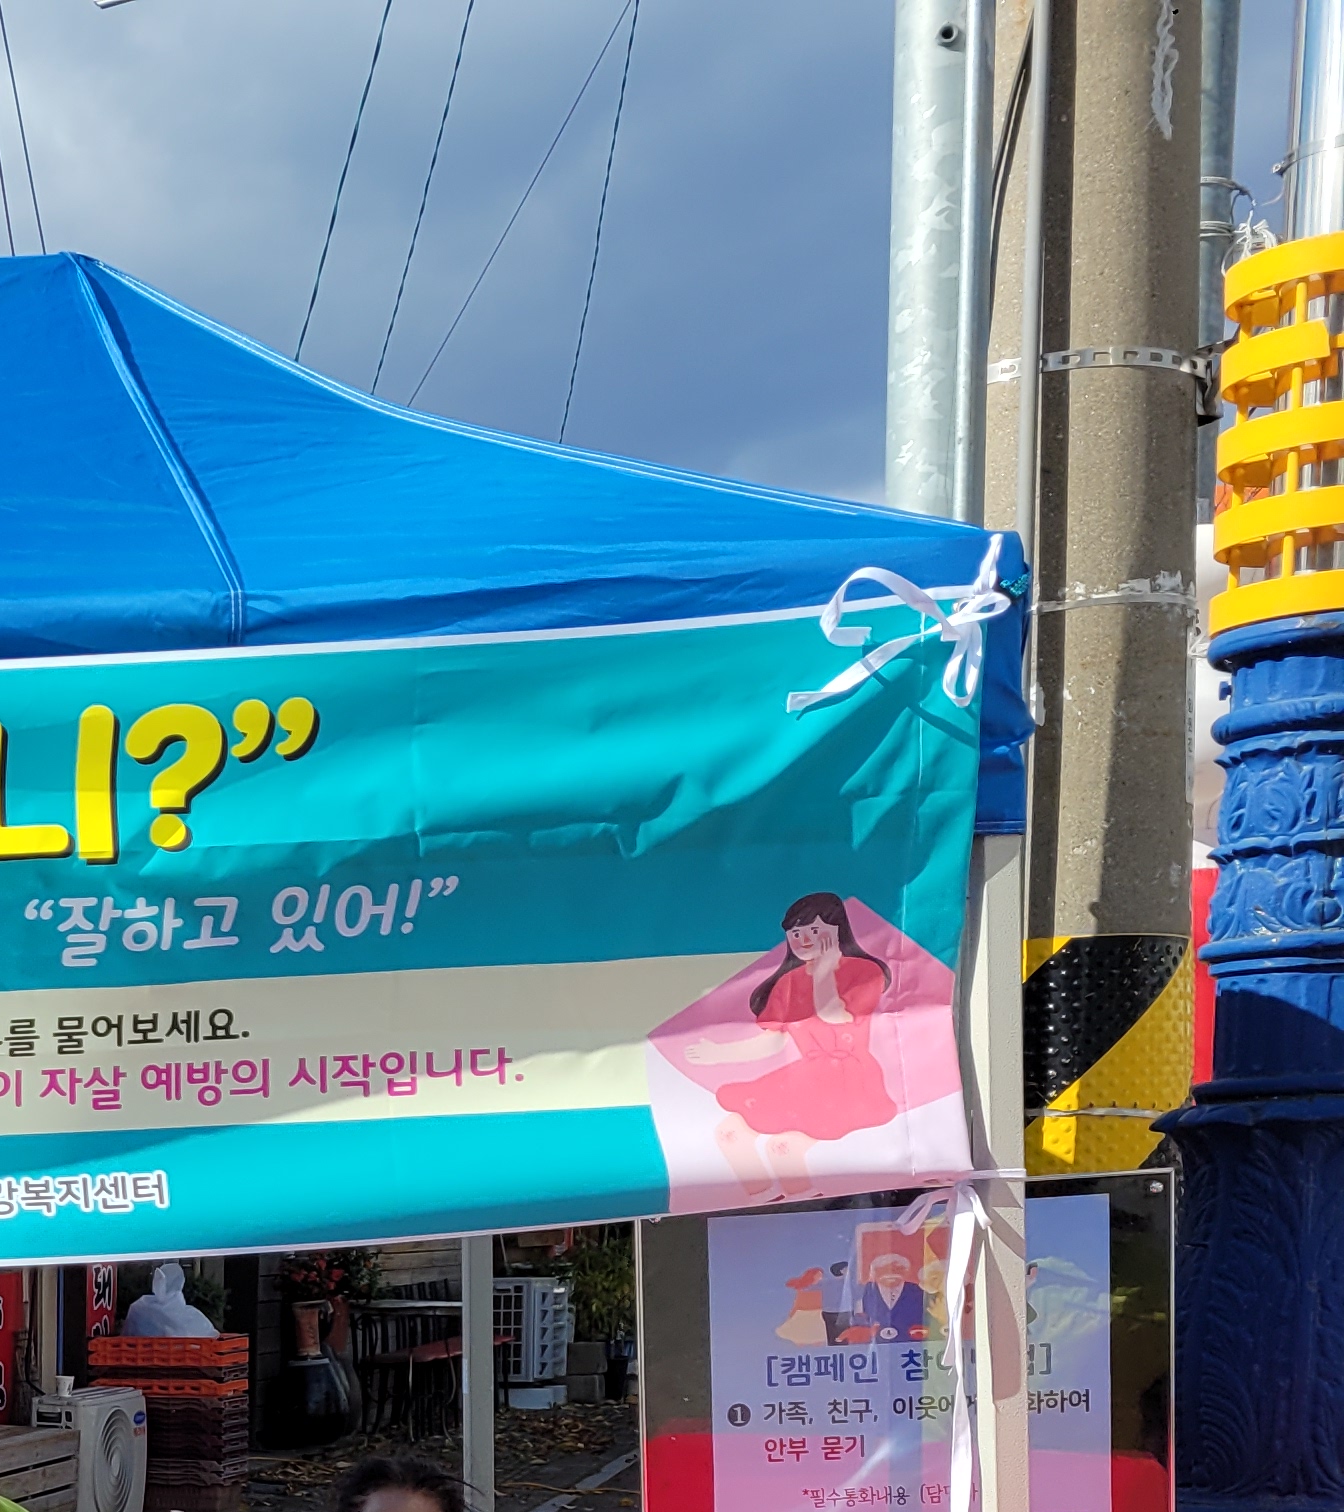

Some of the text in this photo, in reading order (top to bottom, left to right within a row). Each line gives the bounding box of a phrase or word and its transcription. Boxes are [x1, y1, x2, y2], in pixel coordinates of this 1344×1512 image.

[23, 894, 240, 968] “잘하고
[269, 875, 460, 956] 있어!”
[51, 1007, 252, 1056] 물어보세요.
[38, 1063, 126, 1112] 자살
[140, 1056, 271, 1106] 예방의
[288, 1045, 526, 1099] 시작입니다.
[762, 1400, 814, 1426] 가족,
[827, 1398, 878, 1425] 친구,
[764, 1434, 865, 1463] 안부 묻기
